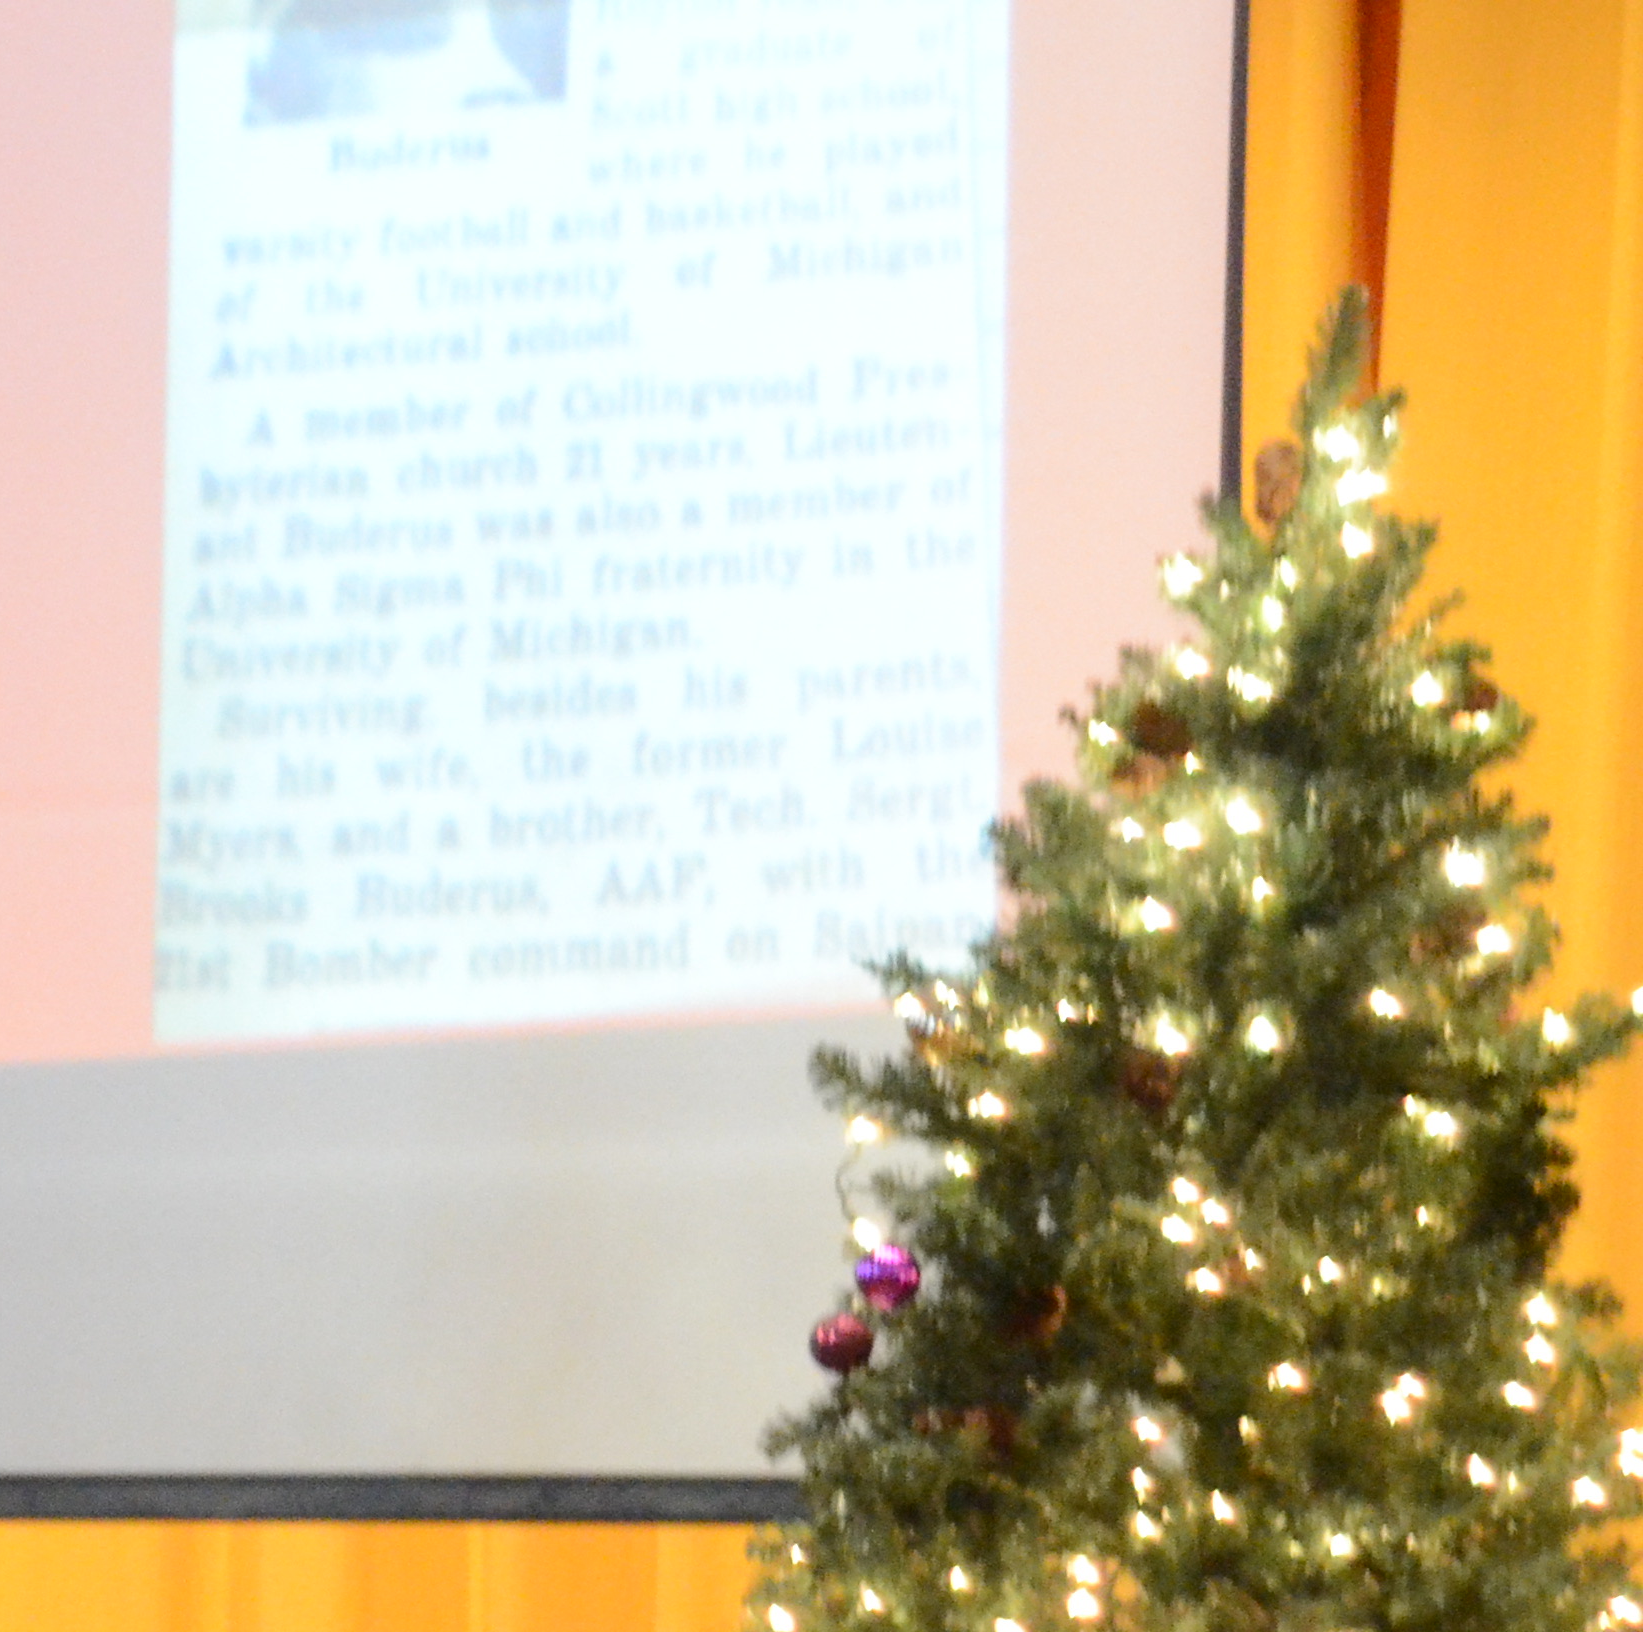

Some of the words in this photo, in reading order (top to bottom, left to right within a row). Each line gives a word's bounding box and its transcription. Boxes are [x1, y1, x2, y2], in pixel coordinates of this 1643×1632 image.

[744, 132, 786, 173] he
[379, 205, 529, 257] football
[550, 195, 621, 243] and
[885, 176, 961, 214] and
[215, 280, 258, 323] of
[305, 276, 365, 315] the
[416, 262, 623, 308] University
[675, 248, 716, 290] of
[765, 235, 964, 284] Michigan
[209, 316, 484, 378] Architectural
[246, 408, 275, 446] A
[305, 393, 469, 441] member
[495, 383, 537, 427] of
[561, 362, 819, 422] Collingwood
[193, 521, 257, 564] ant
[282, 511, 454, 558] Buderus
[475, 505, 554, 543] was
[576, 491, 661, 534] also
[681, 496, 703, 527] a
[727, 473, 906, 525] member
[929, 463, 973, 504] of
[200, 466, 370, 516] byterian
[396, 443, 538, 492] church
[186, 575, 307, 630] Alpha
[333, 571, 465, 616] Sigma
[493, 556, 564, 603] Phi
[592, 539, 806, 597] fraternity
[832, 532, 874, 577] in
[906, 524, 976, 571] the
[182, 630, 401, 680] University
[422, 621, 468, 666] of
[483, 669, 638, 724] besides
[682, 662, 748, 711] his
[170, 768, 236, 801] are
[277, 751, 336, 797] his
[523, 734, 590, 782] the
[632, 728, 788, 776] former
[831, 710, 984, 765] Louise
[333, 809, 410, 855] and
[437, 814, 459, 852] a
[489, 798, 665, 848] brother,
[160, 877, 309, 927] Brooks
[760, 840, 865, 893] with
[263, 938, 439, 988] Bomber
[467, 920, 691, 982] command
[725, 922, 779, 962] on
